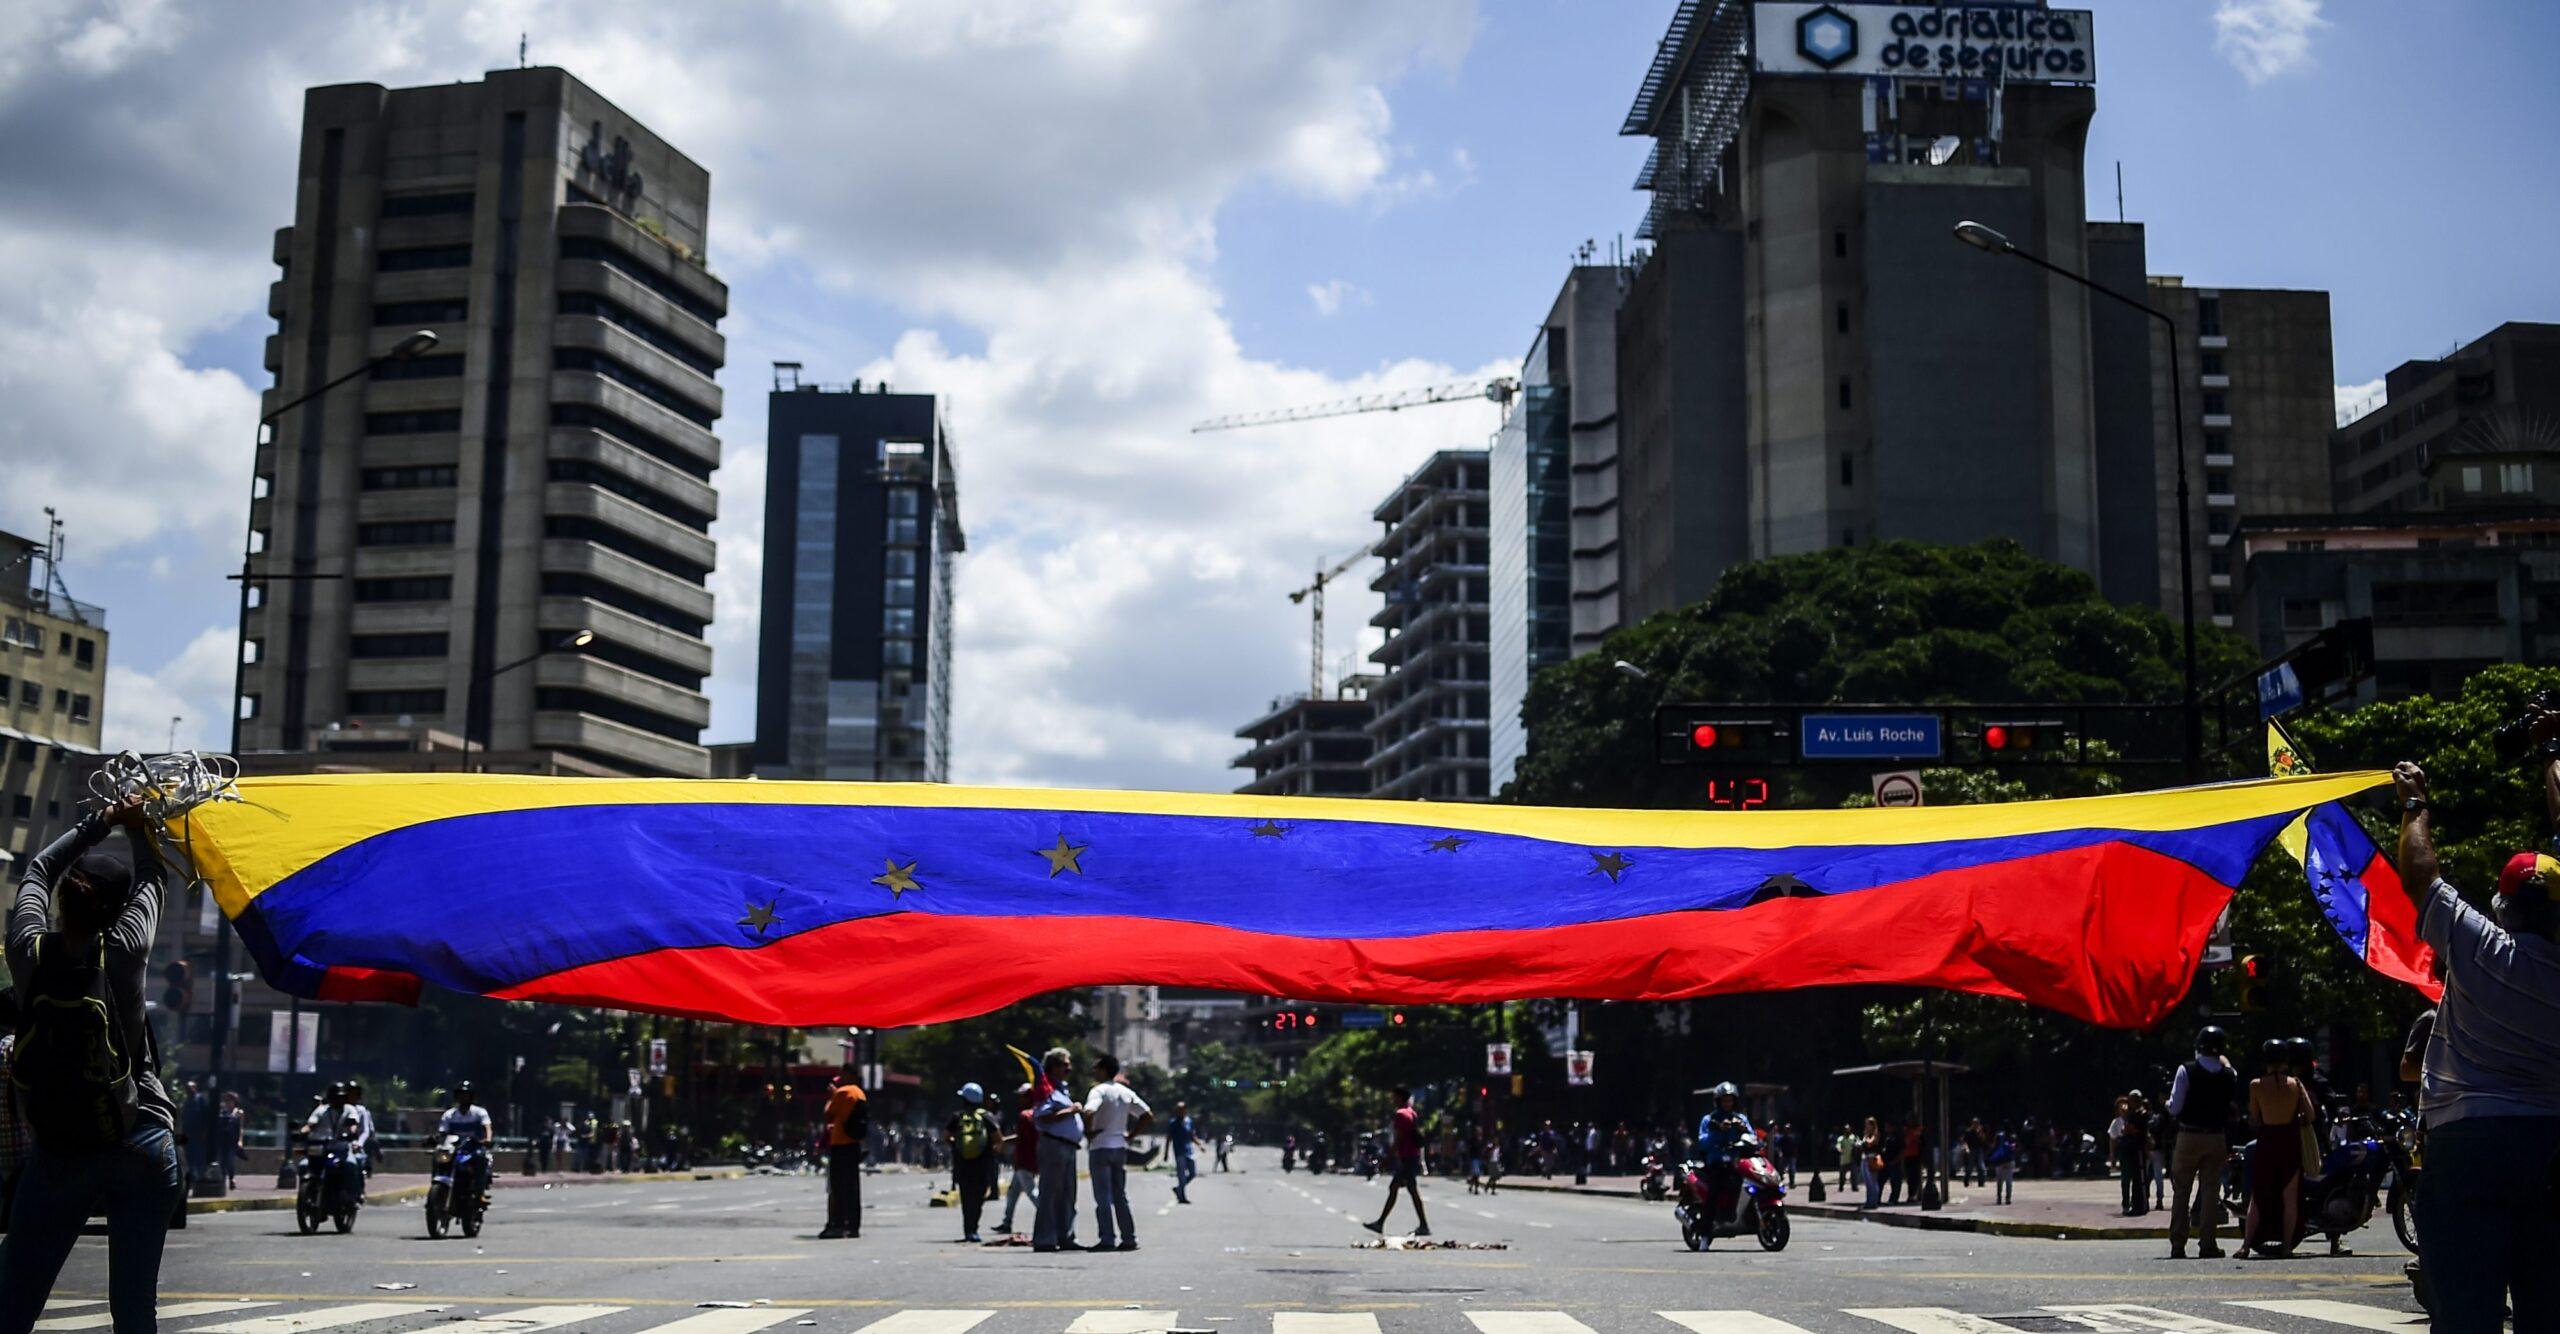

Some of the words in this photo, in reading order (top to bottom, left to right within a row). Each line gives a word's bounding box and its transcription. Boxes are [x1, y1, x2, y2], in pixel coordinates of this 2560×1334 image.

[1881, 37, 1930, 68] de
[1938, 45, 2087, 80] seguros
[1818, 727, 1841, 742] Av.
[1843, 727, 1875, 743] Luis
[1879, 726, 1926, 743] Roche
[1274, 1012, 1297, 1030] 27
